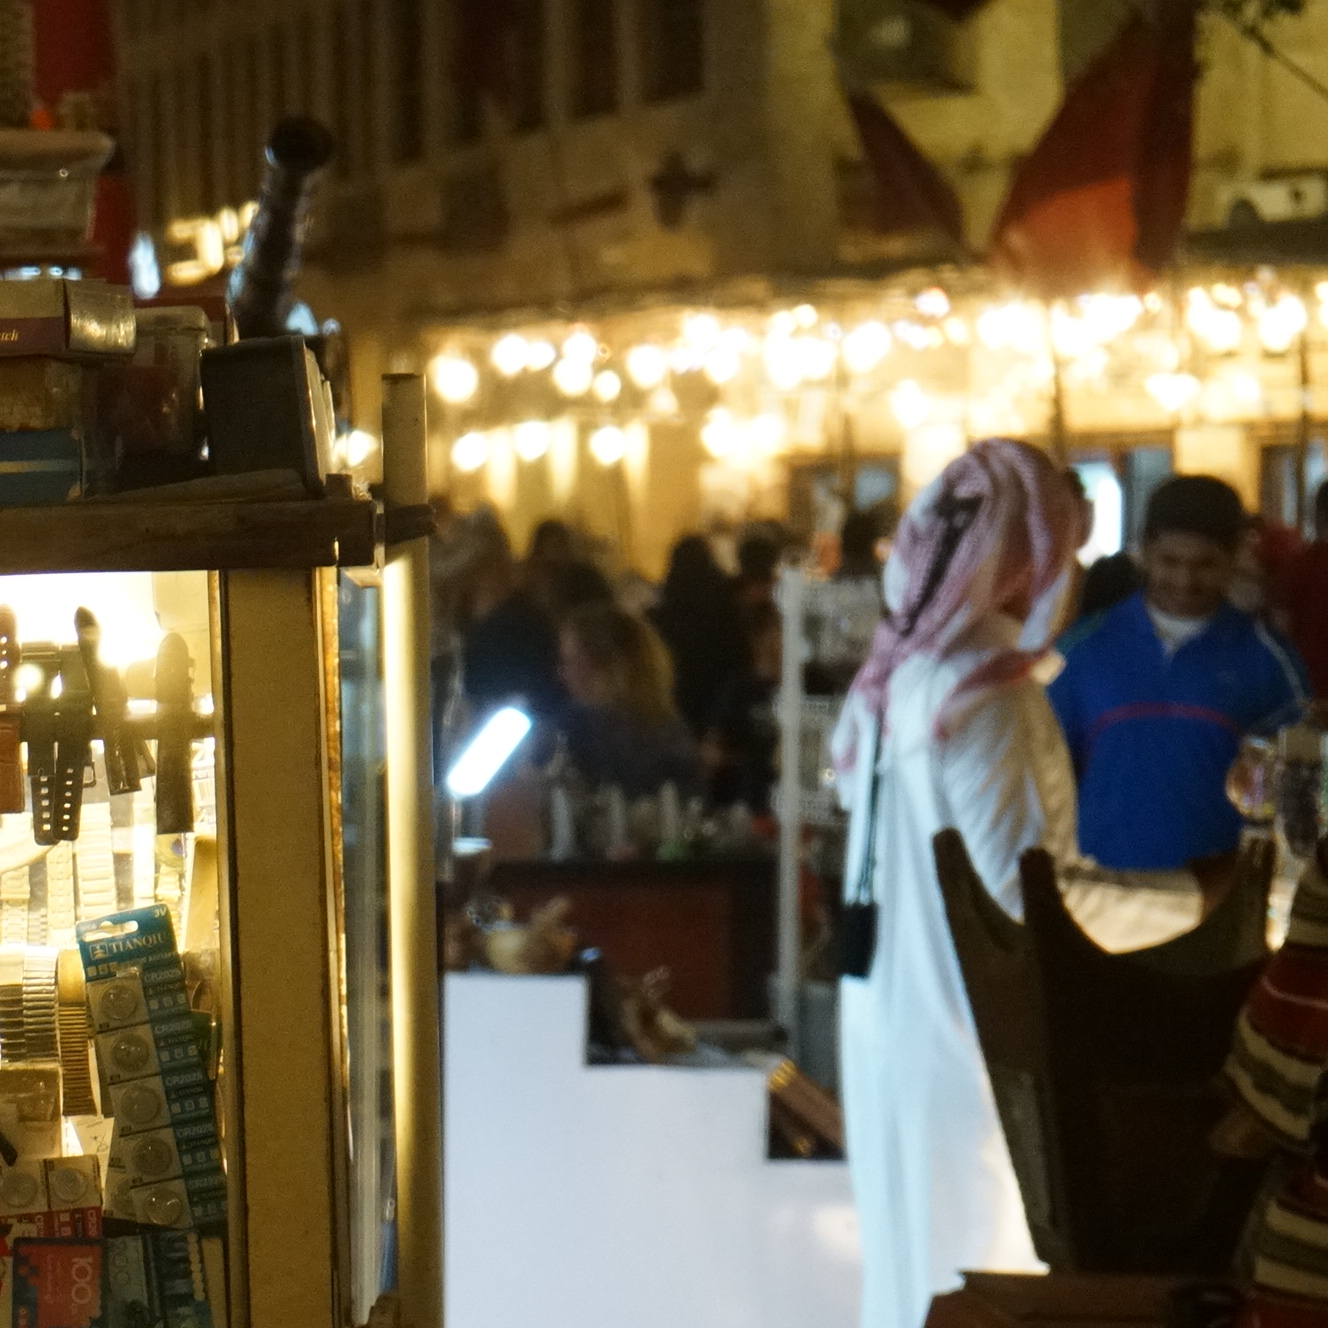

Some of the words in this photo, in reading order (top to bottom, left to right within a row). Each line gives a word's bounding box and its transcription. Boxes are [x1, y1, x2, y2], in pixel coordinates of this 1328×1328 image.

[154, 907, 166, 918] 3V
[109, 931, 166, 954] TIANQIU
[88, 1210, 97, 1236] CR20
[71, 1257, 93, 1304] 100
